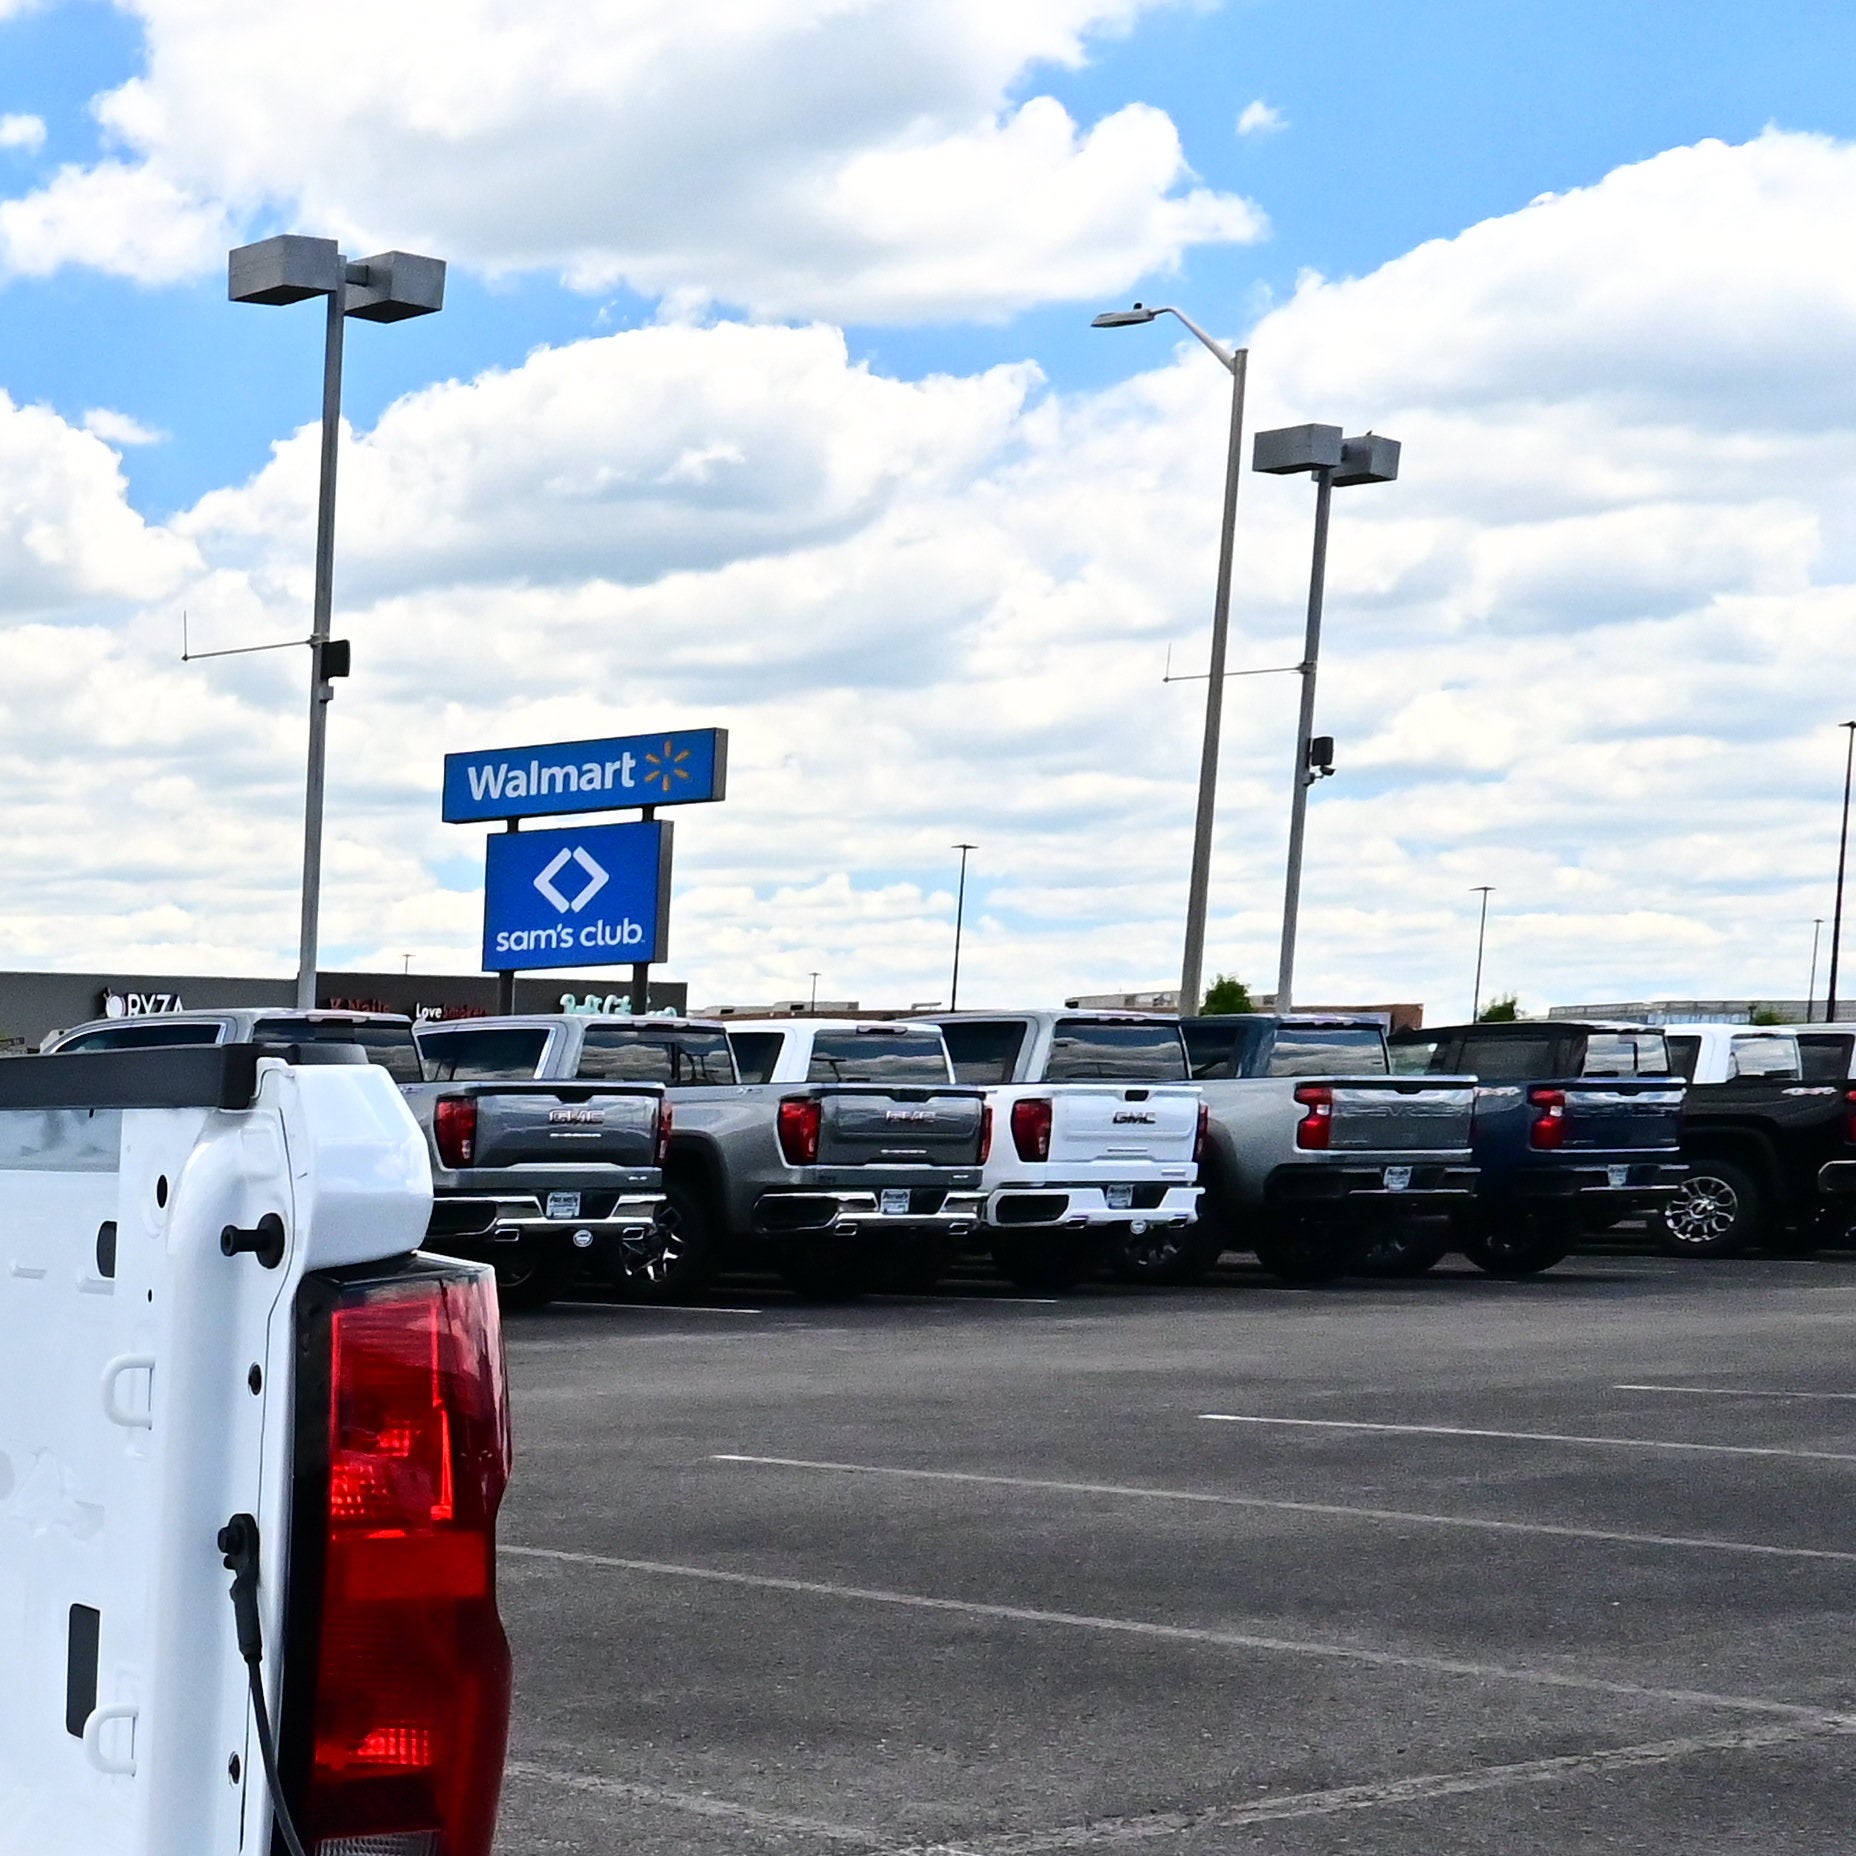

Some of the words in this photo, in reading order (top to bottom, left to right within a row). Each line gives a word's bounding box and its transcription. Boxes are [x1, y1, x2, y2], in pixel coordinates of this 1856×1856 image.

[467, 751, 637, 801] Walmart
[495, 923, 574, 952] sam's
[579, 917, 643, 946] club
[415, 1002, 442, 1018] Love
[1112, 1111, 1156, 1124] GMC
